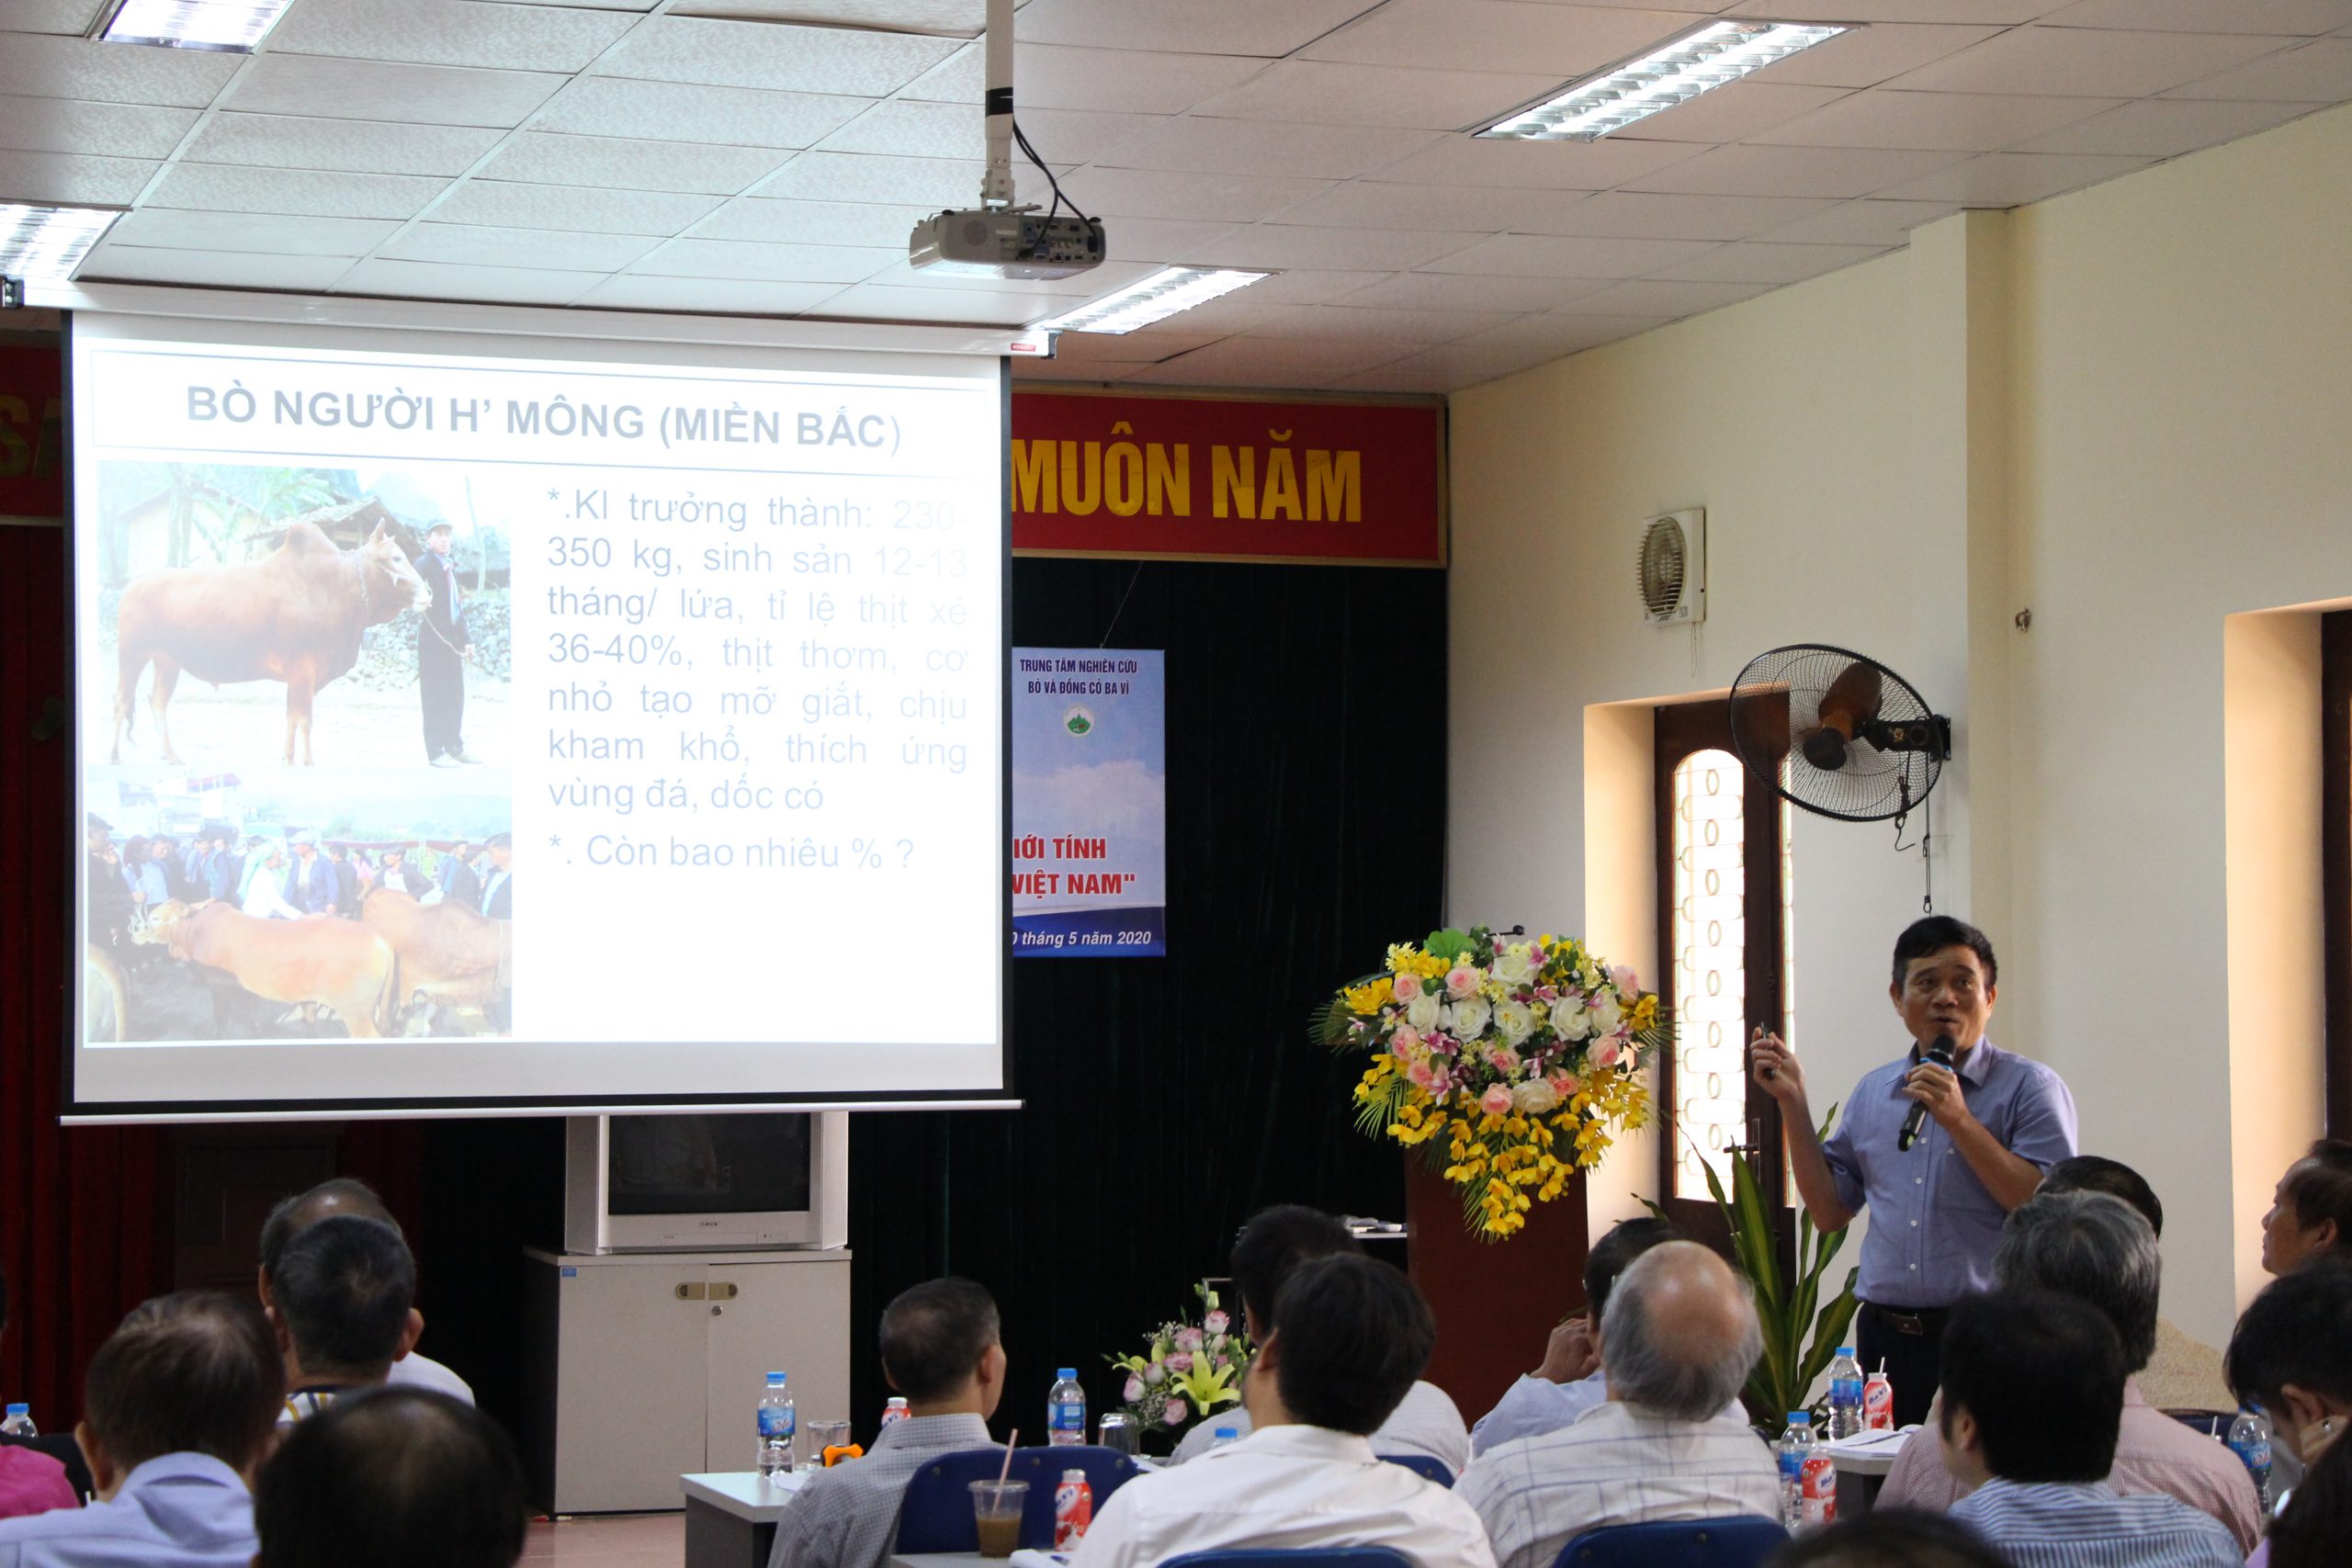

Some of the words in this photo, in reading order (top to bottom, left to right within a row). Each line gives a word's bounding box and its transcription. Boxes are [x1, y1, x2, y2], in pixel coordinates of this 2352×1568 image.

[187, 379, 256, 423] BÒ
[275, 387, 433, 430] NGƯỜI
[507, 394, 644, 439] MÔNG
[660, 400, 779, 449] (MIỀN
[1012, 421, 1191, 517] MUÔN
[1211, 428, 1362, 523] NĂM
[628, 490, 747, 534] trưởng
[767, 494, 871, 528] thành:
[894, 501, 968, 530] 230-
[548, 536, 612, 570] 350
[633, 538, 682, 578] kg,
[704, 541, 772, 573] sinh
[793, 543, 851, 574] sản
[876, 547, 967, 578] 12-13
[547, 584, 659, 626] tháng/
[681, 586, 743, 624] lứa,
[767, 589, 787, 621] tỉ
[809, 592, 835, 628] lệ
[858, 593, 908, 629] thịt
[548, 632, 692, 671] 36-40%,
[722, 637, 774, 674] thịt
[800, 639, 896, 675] thơm,
[926, 649, 969, 671] cơ
[1020, 659, 1052, 672] TRUNG
[1056, 658, 1076, 672] TÂM
[1079, 658, 1115, 673] NGHIÊN
[1118, 658, 1137, 673] CỨU
[548, 679, 613, 713] nhỏ
[639, 684, 693, 720] tạo
[721, 685, 777, 716] mỡ
[802, 681, 871, 724] giắt,
[900, 690, 967, 725] chịu
[1104, 682, 1117, 694] BA
[549, 728, 644, 761] kham
[681, 724, 750, 767] khổ,
[786, 733, 866, 763] thích
[902, 735, 967, 774] ứng
[548, 775, 633, 817] vùng
[646, 778, 697, 814] đá,
[710, 771, 774, 809] dốc
[785, 779, 823, 809] có
[587, 834, 657, 866] Còn
[670, 836, 734, 867] bao
[746, 837, 838, 868] nhiêu
[852, 838, 882, 869] %
[896, 839, 914, 869] ?
[1053, 834, 1106, 859] TÍNH
[1012, 869, 1059, 899] VIỆT
[1068, 874, 1136, 895] NAM"
[1022, 931, 1065, 948] tháng
[1069, 931, 1078, 945] 5
[1081, 931, 1113, 945] năm
[1117, 931, 1152, 945] 2020
